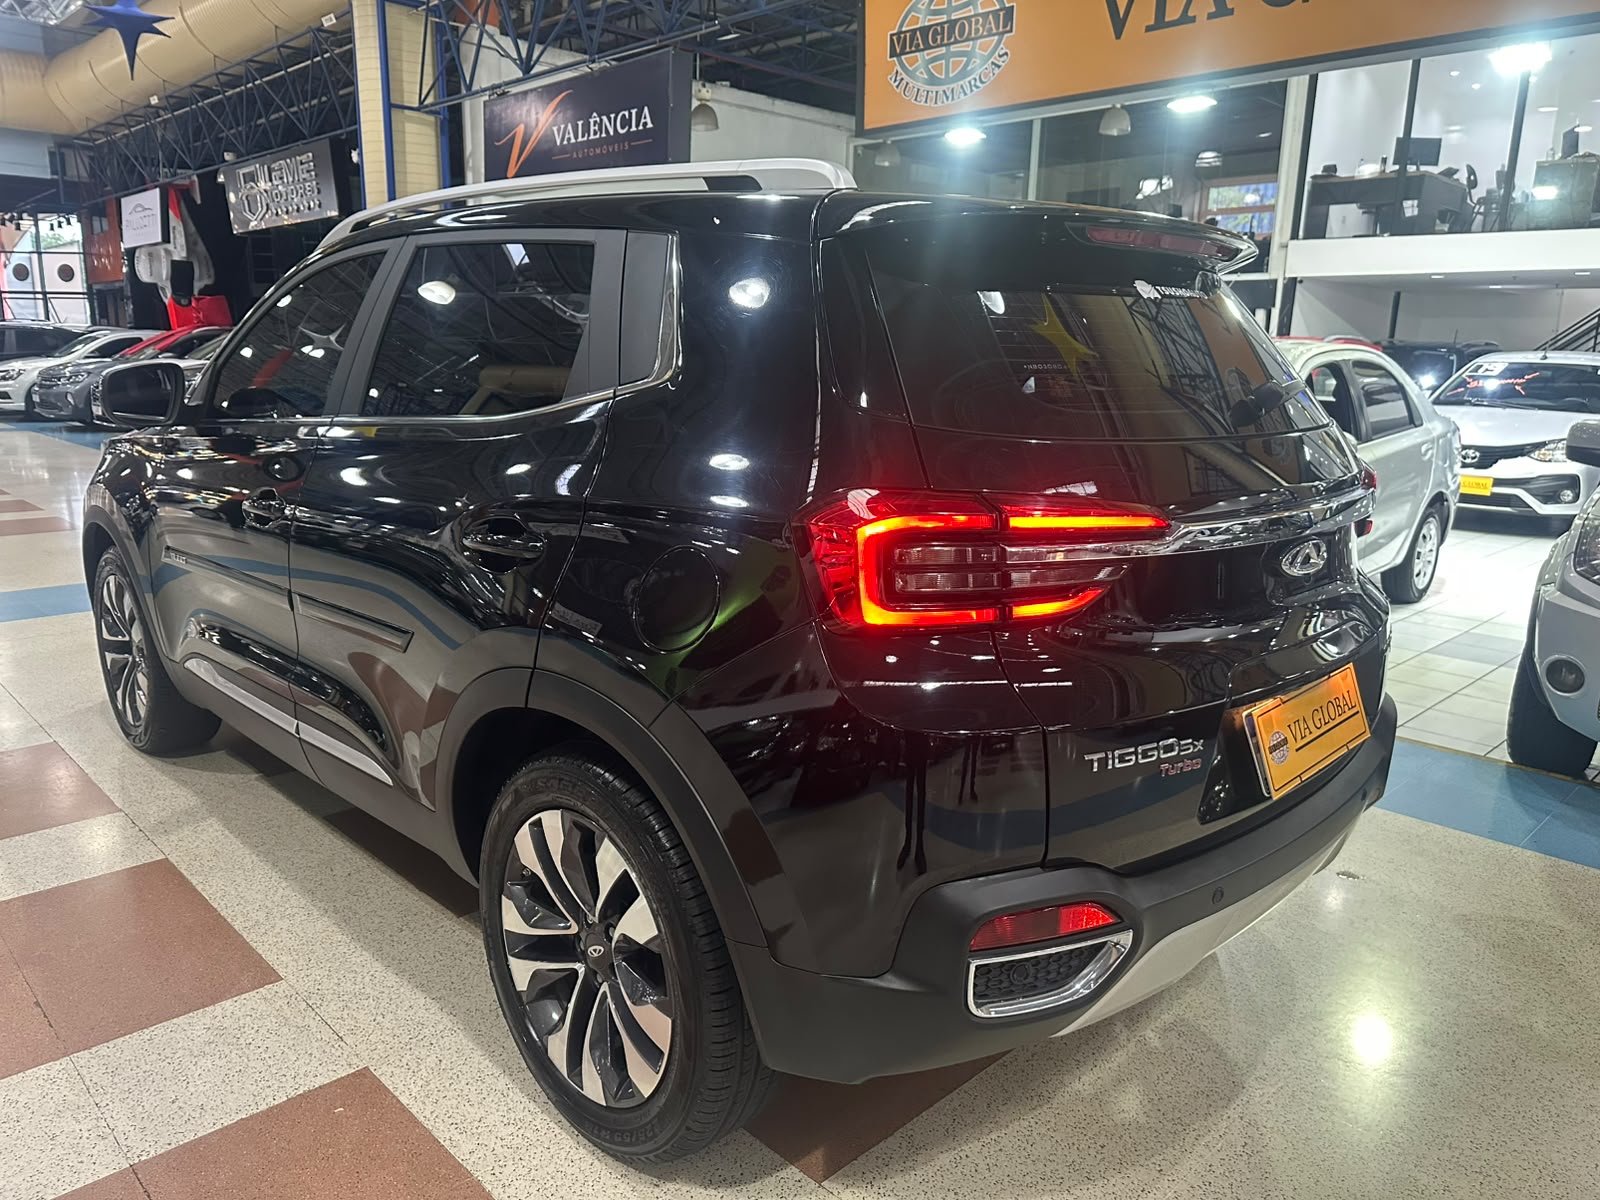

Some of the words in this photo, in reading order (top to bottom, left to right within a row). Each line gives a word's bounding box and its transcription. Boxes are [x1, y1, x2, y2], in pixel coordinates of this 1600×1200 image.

[892, 30, 925, 55] VIA
[928, 10, 1013, 47] GLOBAL
[889, 46, 1011, 105] MULTIMARCAS
[552, 105, 654, 147] VALÊNCIA
[571, 142, 630, 159] AUTOMÓVEIS
[1287, 715, 1313, 743] VIA
[1311, 689, 1357, 730] GLOBAL
